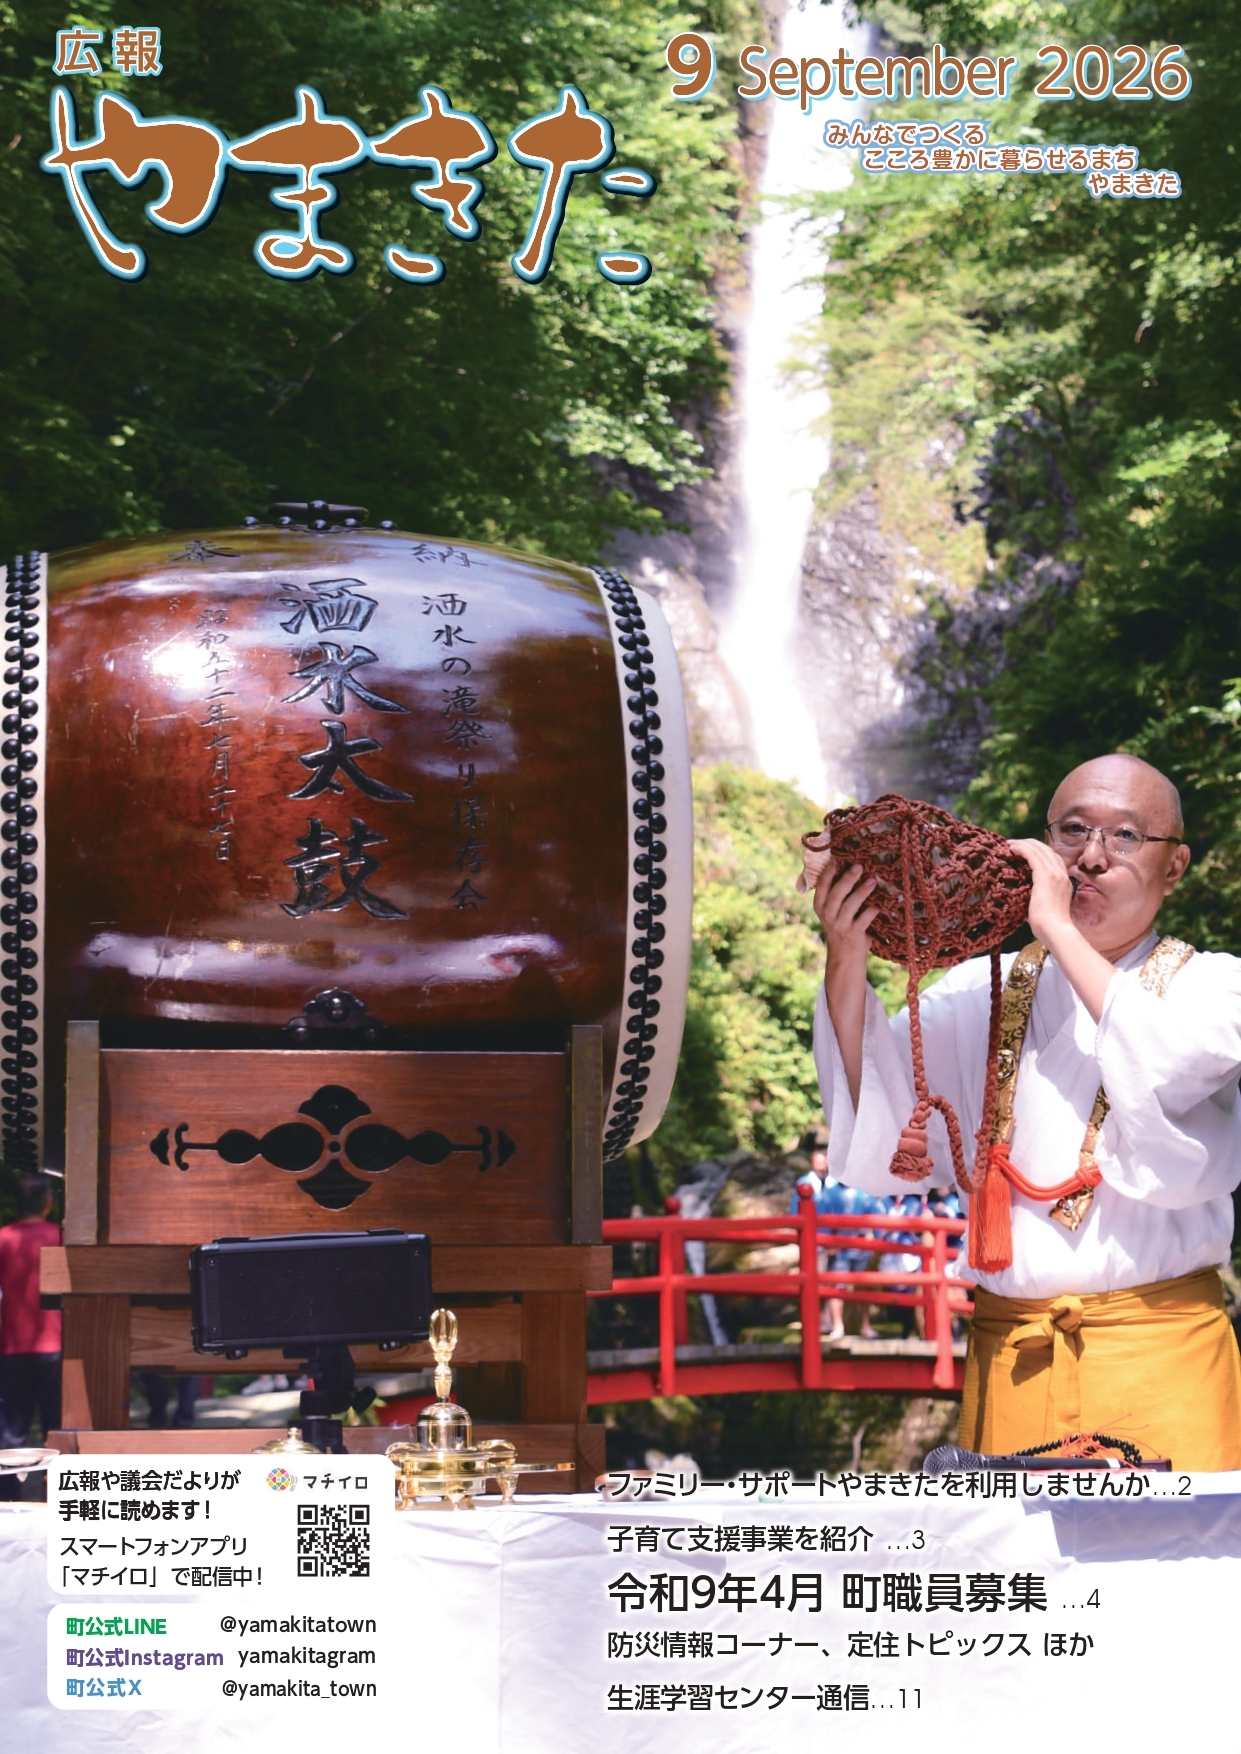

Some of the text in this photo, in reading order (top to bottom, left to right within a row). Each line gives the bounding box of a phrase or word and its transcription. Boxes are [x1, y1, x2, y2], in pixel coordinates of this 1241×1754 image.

[195, 608, 240, 861] 昭和五十二年七月二十七日
[279, 577, 413, 920] 洒水太鼓
[421, 592, 493, 910] 洒水の滝祭り保存会
